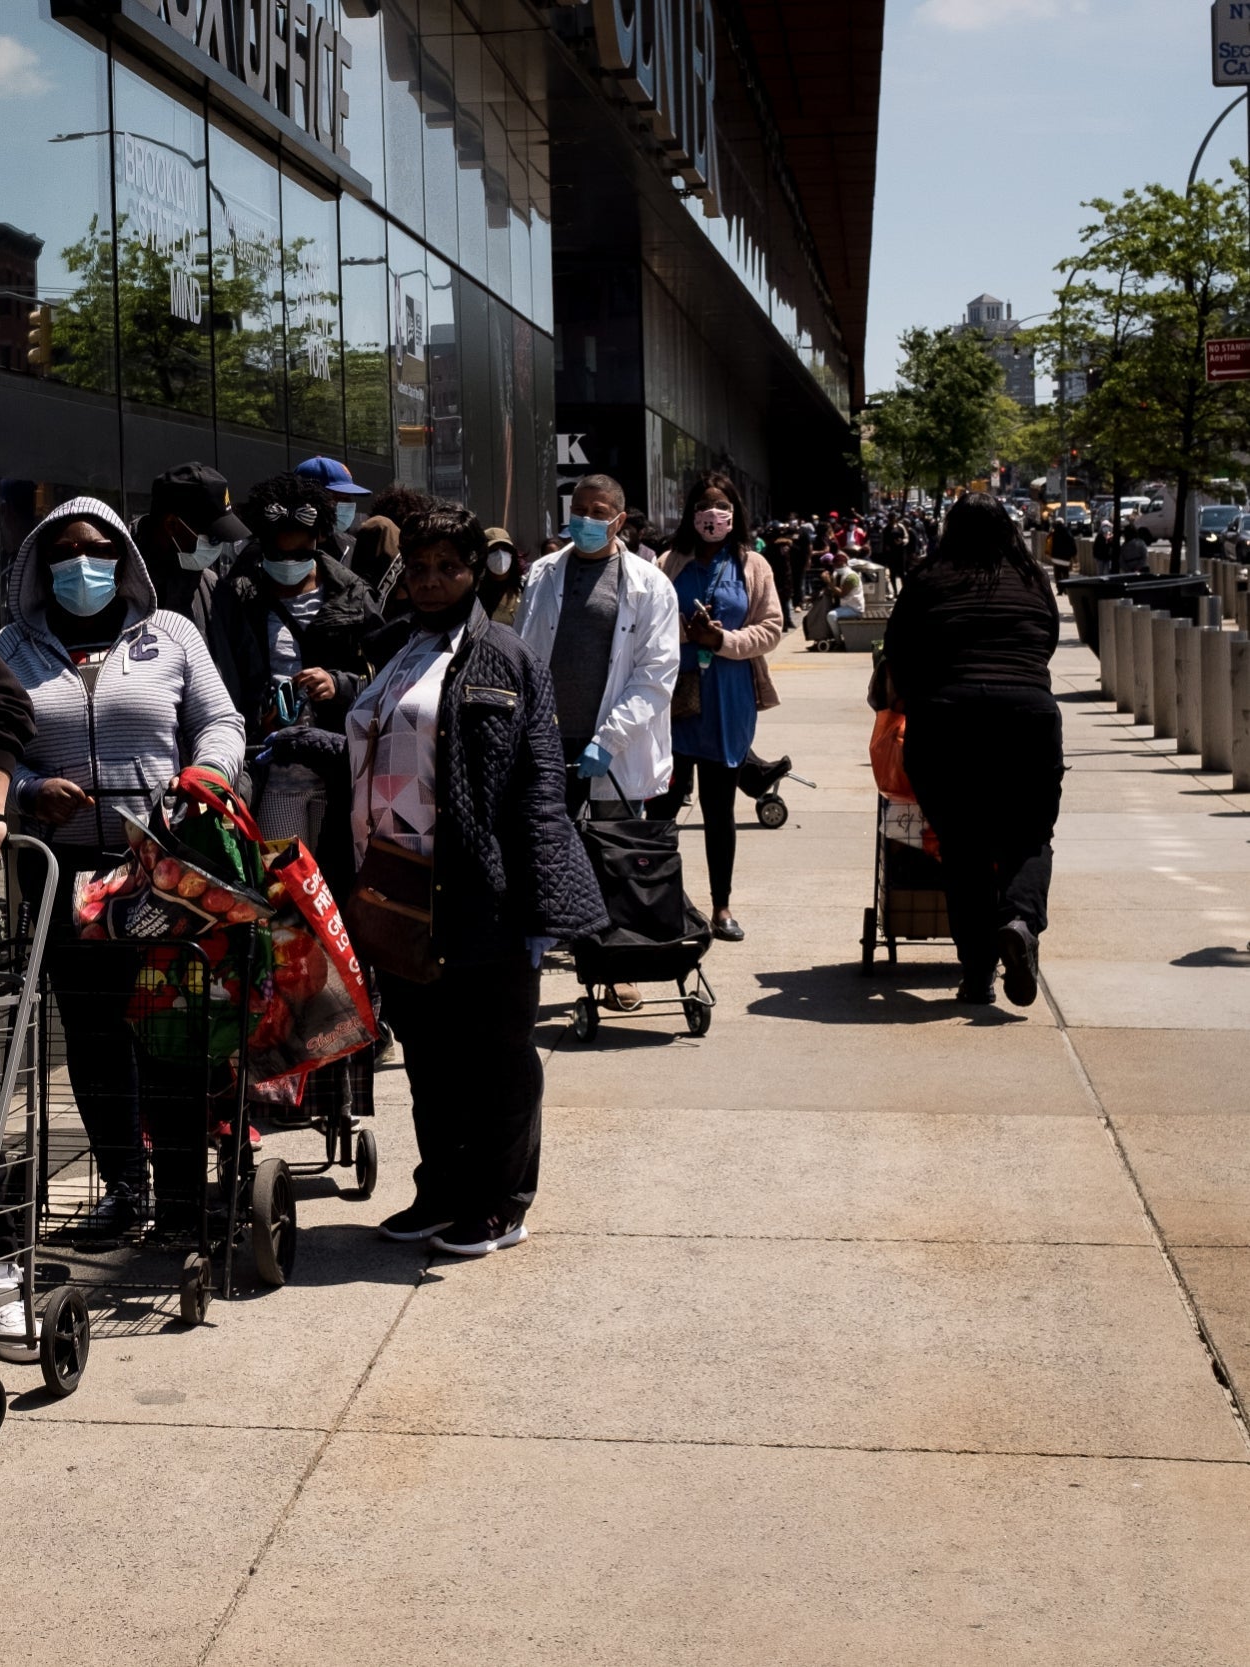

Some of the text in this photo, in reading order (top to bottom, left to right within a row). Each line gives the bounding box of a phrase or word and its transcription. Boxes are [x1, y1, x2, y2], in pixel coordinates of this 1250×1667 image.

[124, 132, 198, 218] BROOKLYN
[170, 268, 202, 324] MIND
[308, 336, 331, 381] YORK
[1208, 344, 1220, 352] NO
[126, 907, 164, 936] LOCALLY.
[137, 914, 168, 938] GROWN
